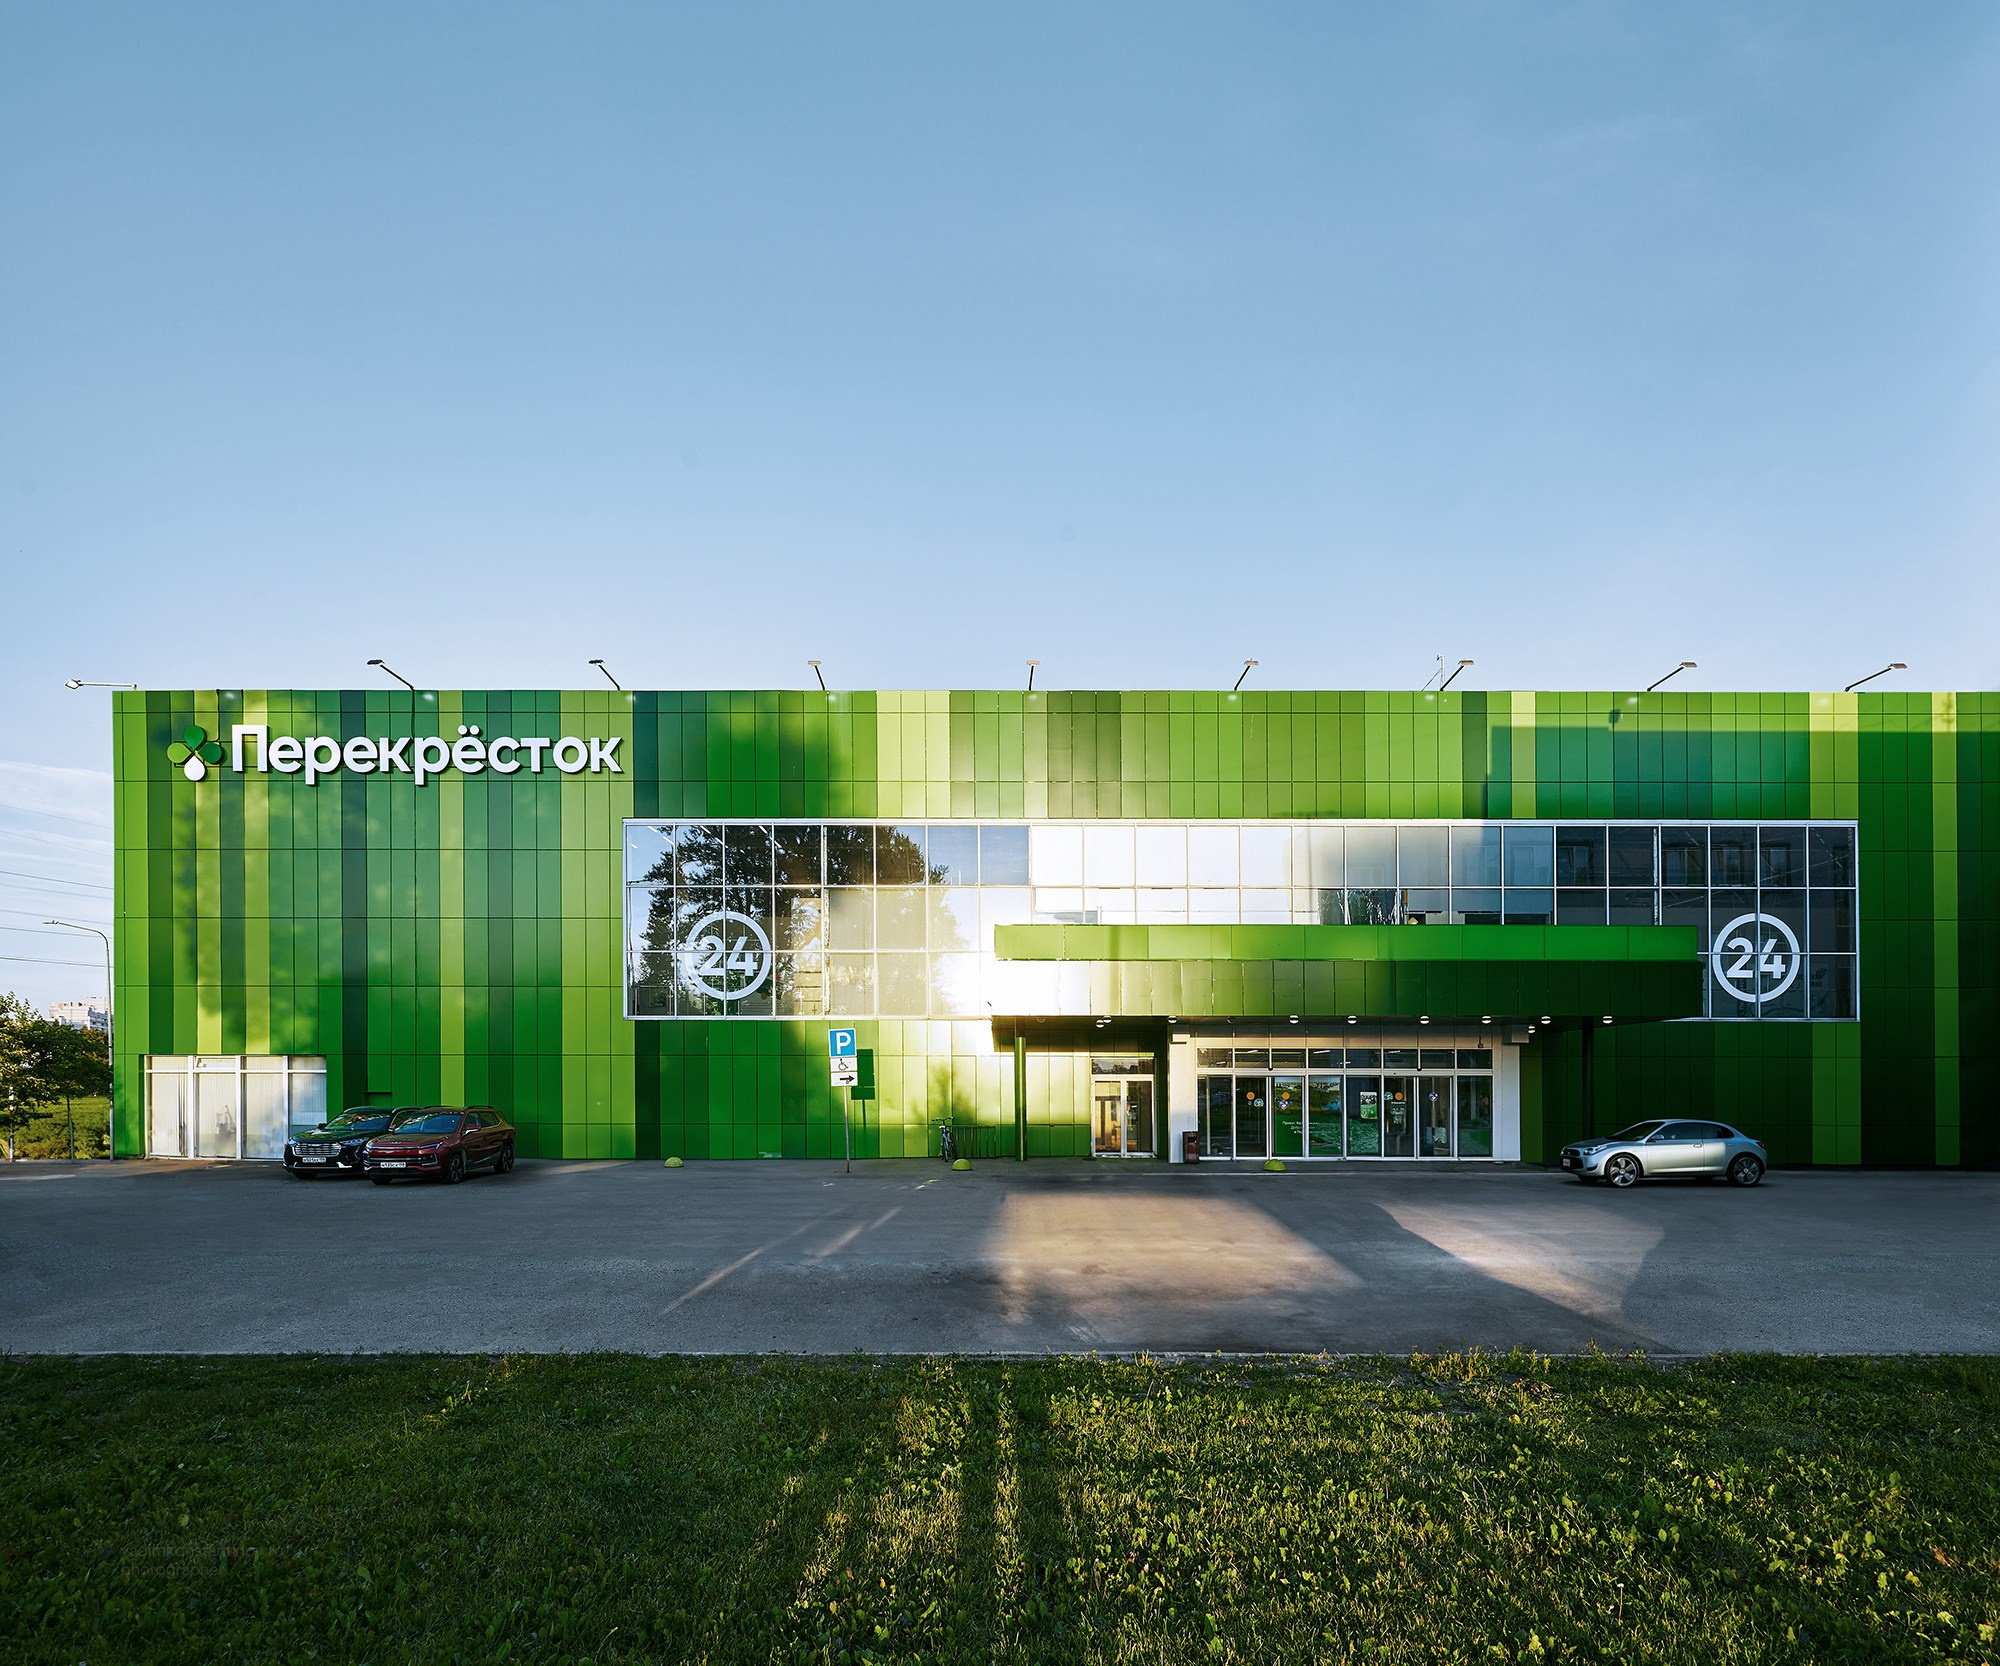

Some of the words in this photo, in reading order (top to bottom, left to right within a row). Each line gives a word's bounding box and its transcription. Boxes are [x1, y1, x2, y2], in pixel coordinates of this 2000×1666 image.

[230, 724, 624, 787] Перекрёсток
[699, 935, 758, 976] 24
[1726, 937, 1786, 979] 24
[835, 1031, 852, 1055] P
